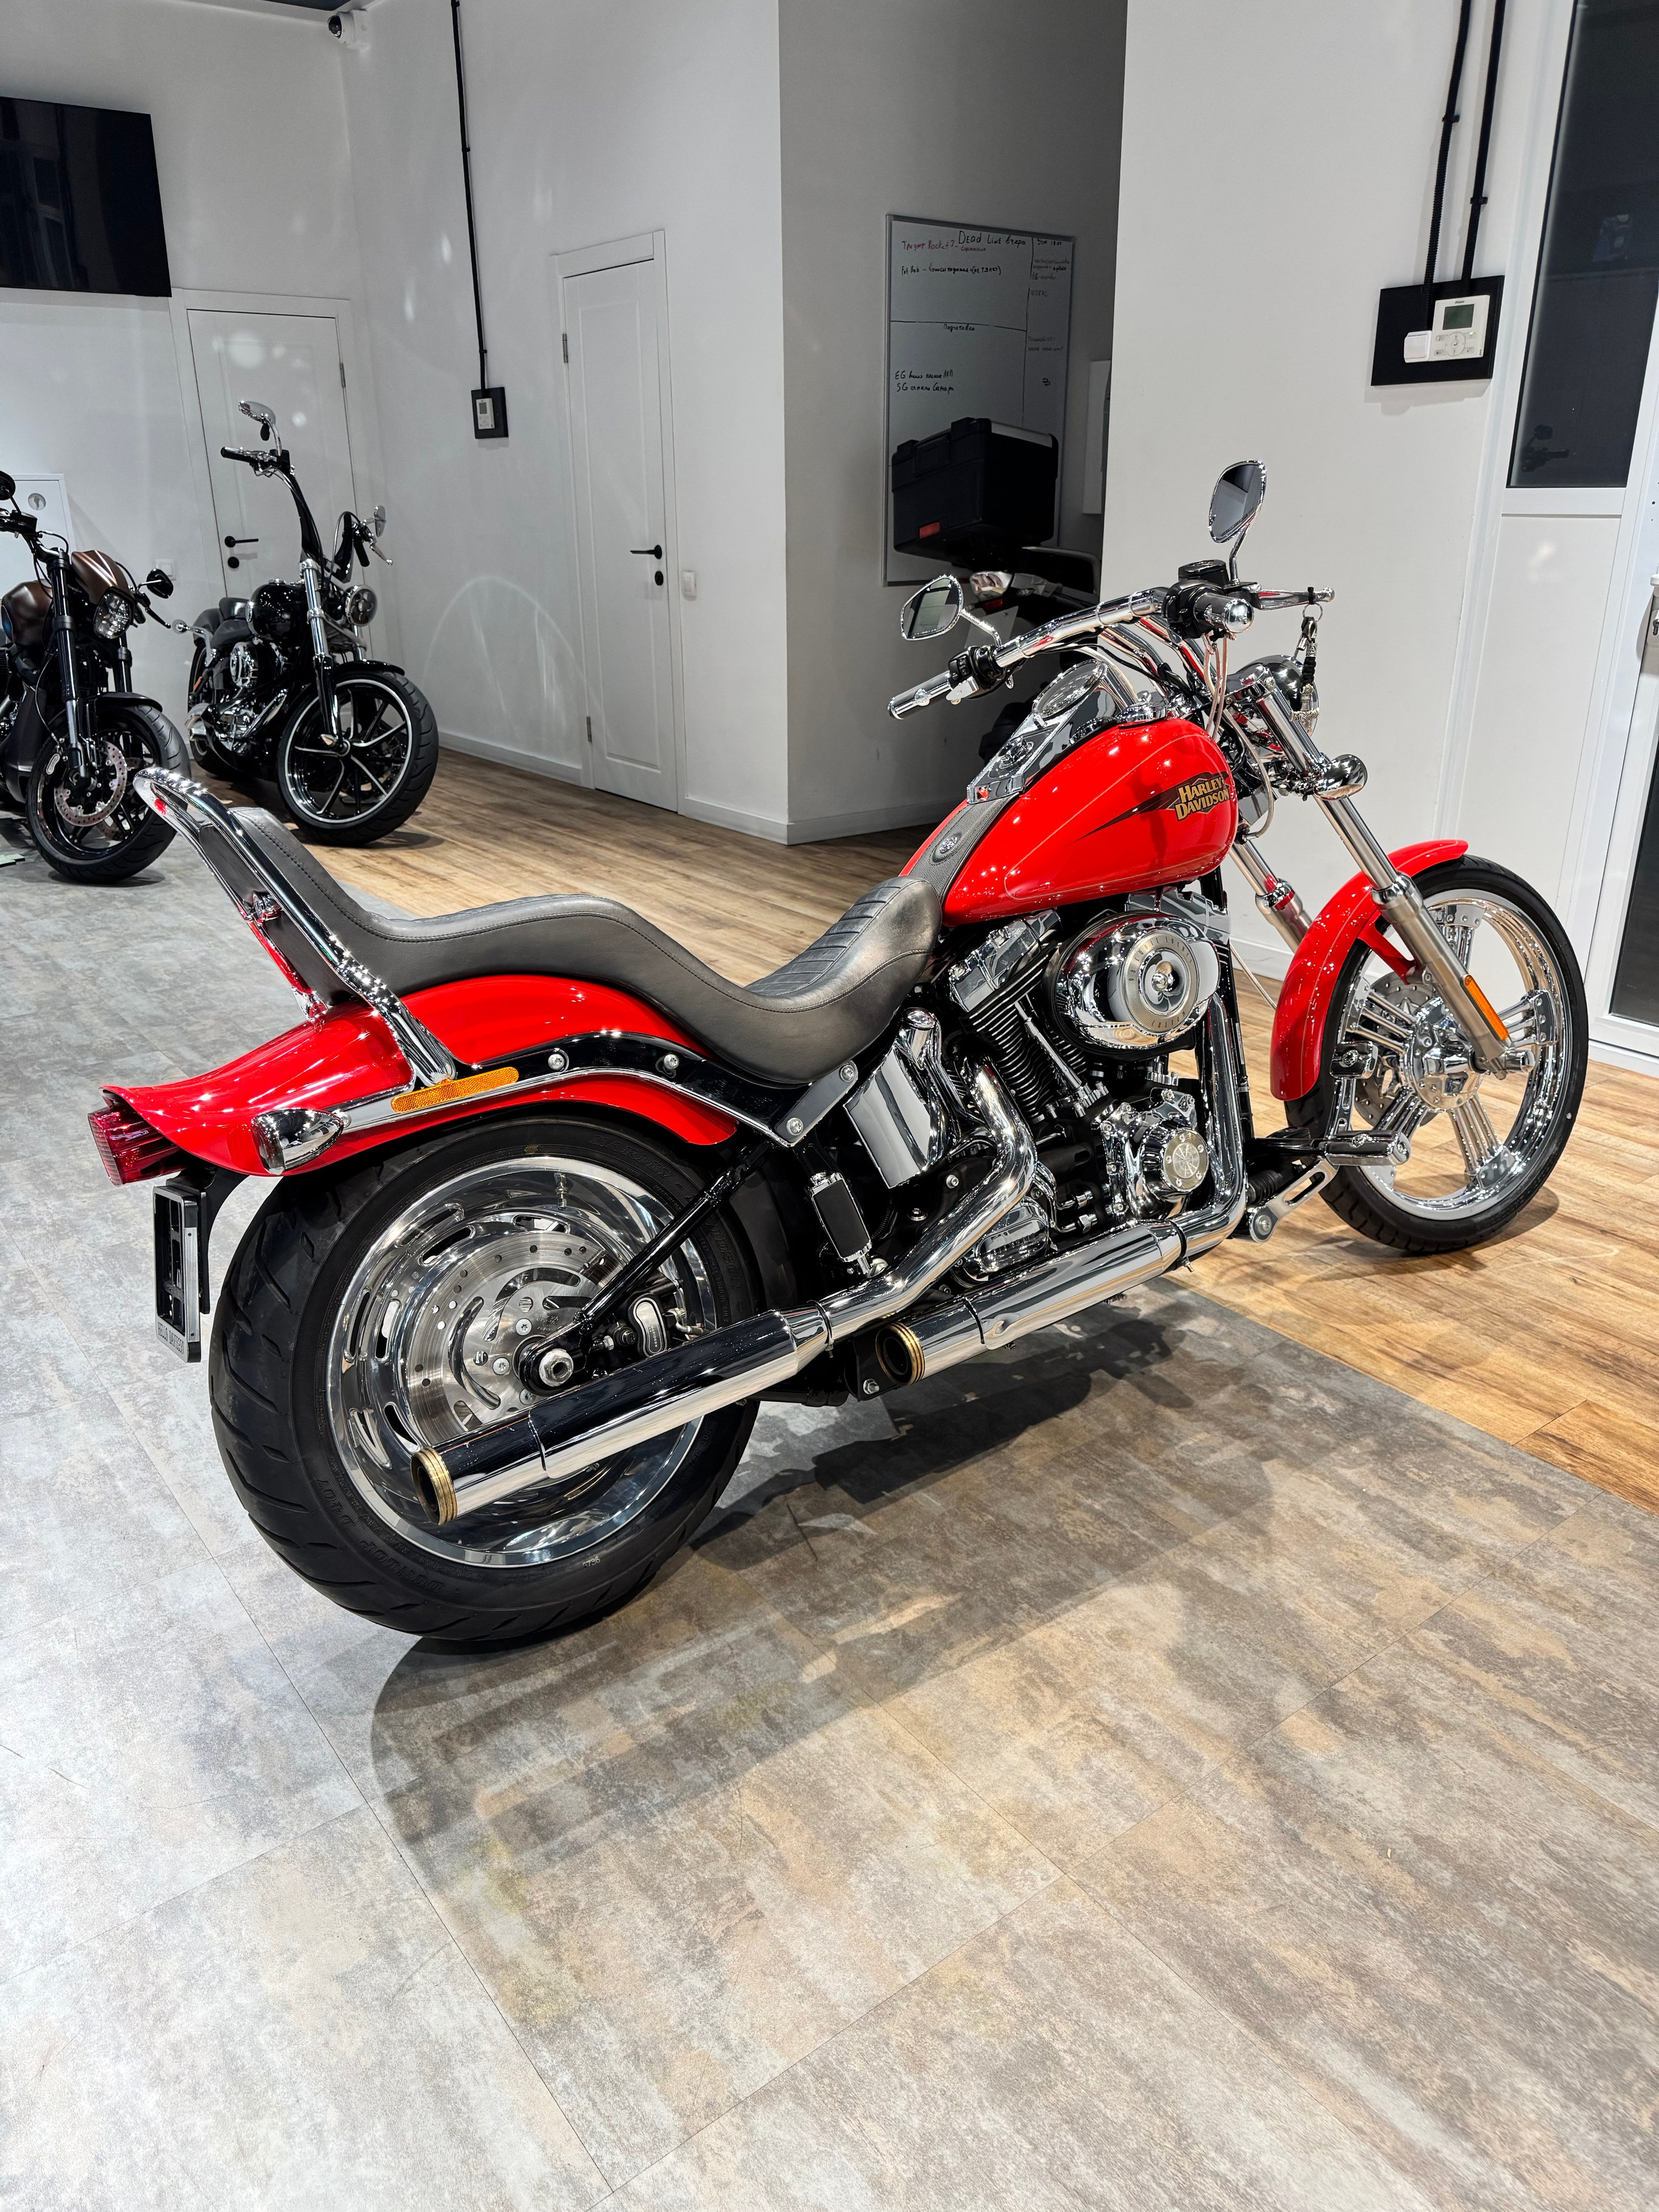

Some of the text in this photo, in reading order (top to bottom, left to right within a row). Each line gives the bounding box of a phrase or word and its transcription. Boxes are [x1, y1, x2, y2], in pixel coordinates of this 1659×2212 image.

[1174, 787, 1230, 821] DAVIDSON
[1178, 776, 1222, 803] HARLEY
[588, 1135, 675, 1179] HARLEY
[314, 1479, 355, 1528] D407
[358, 1539, 445, 1593] DUNLOP
